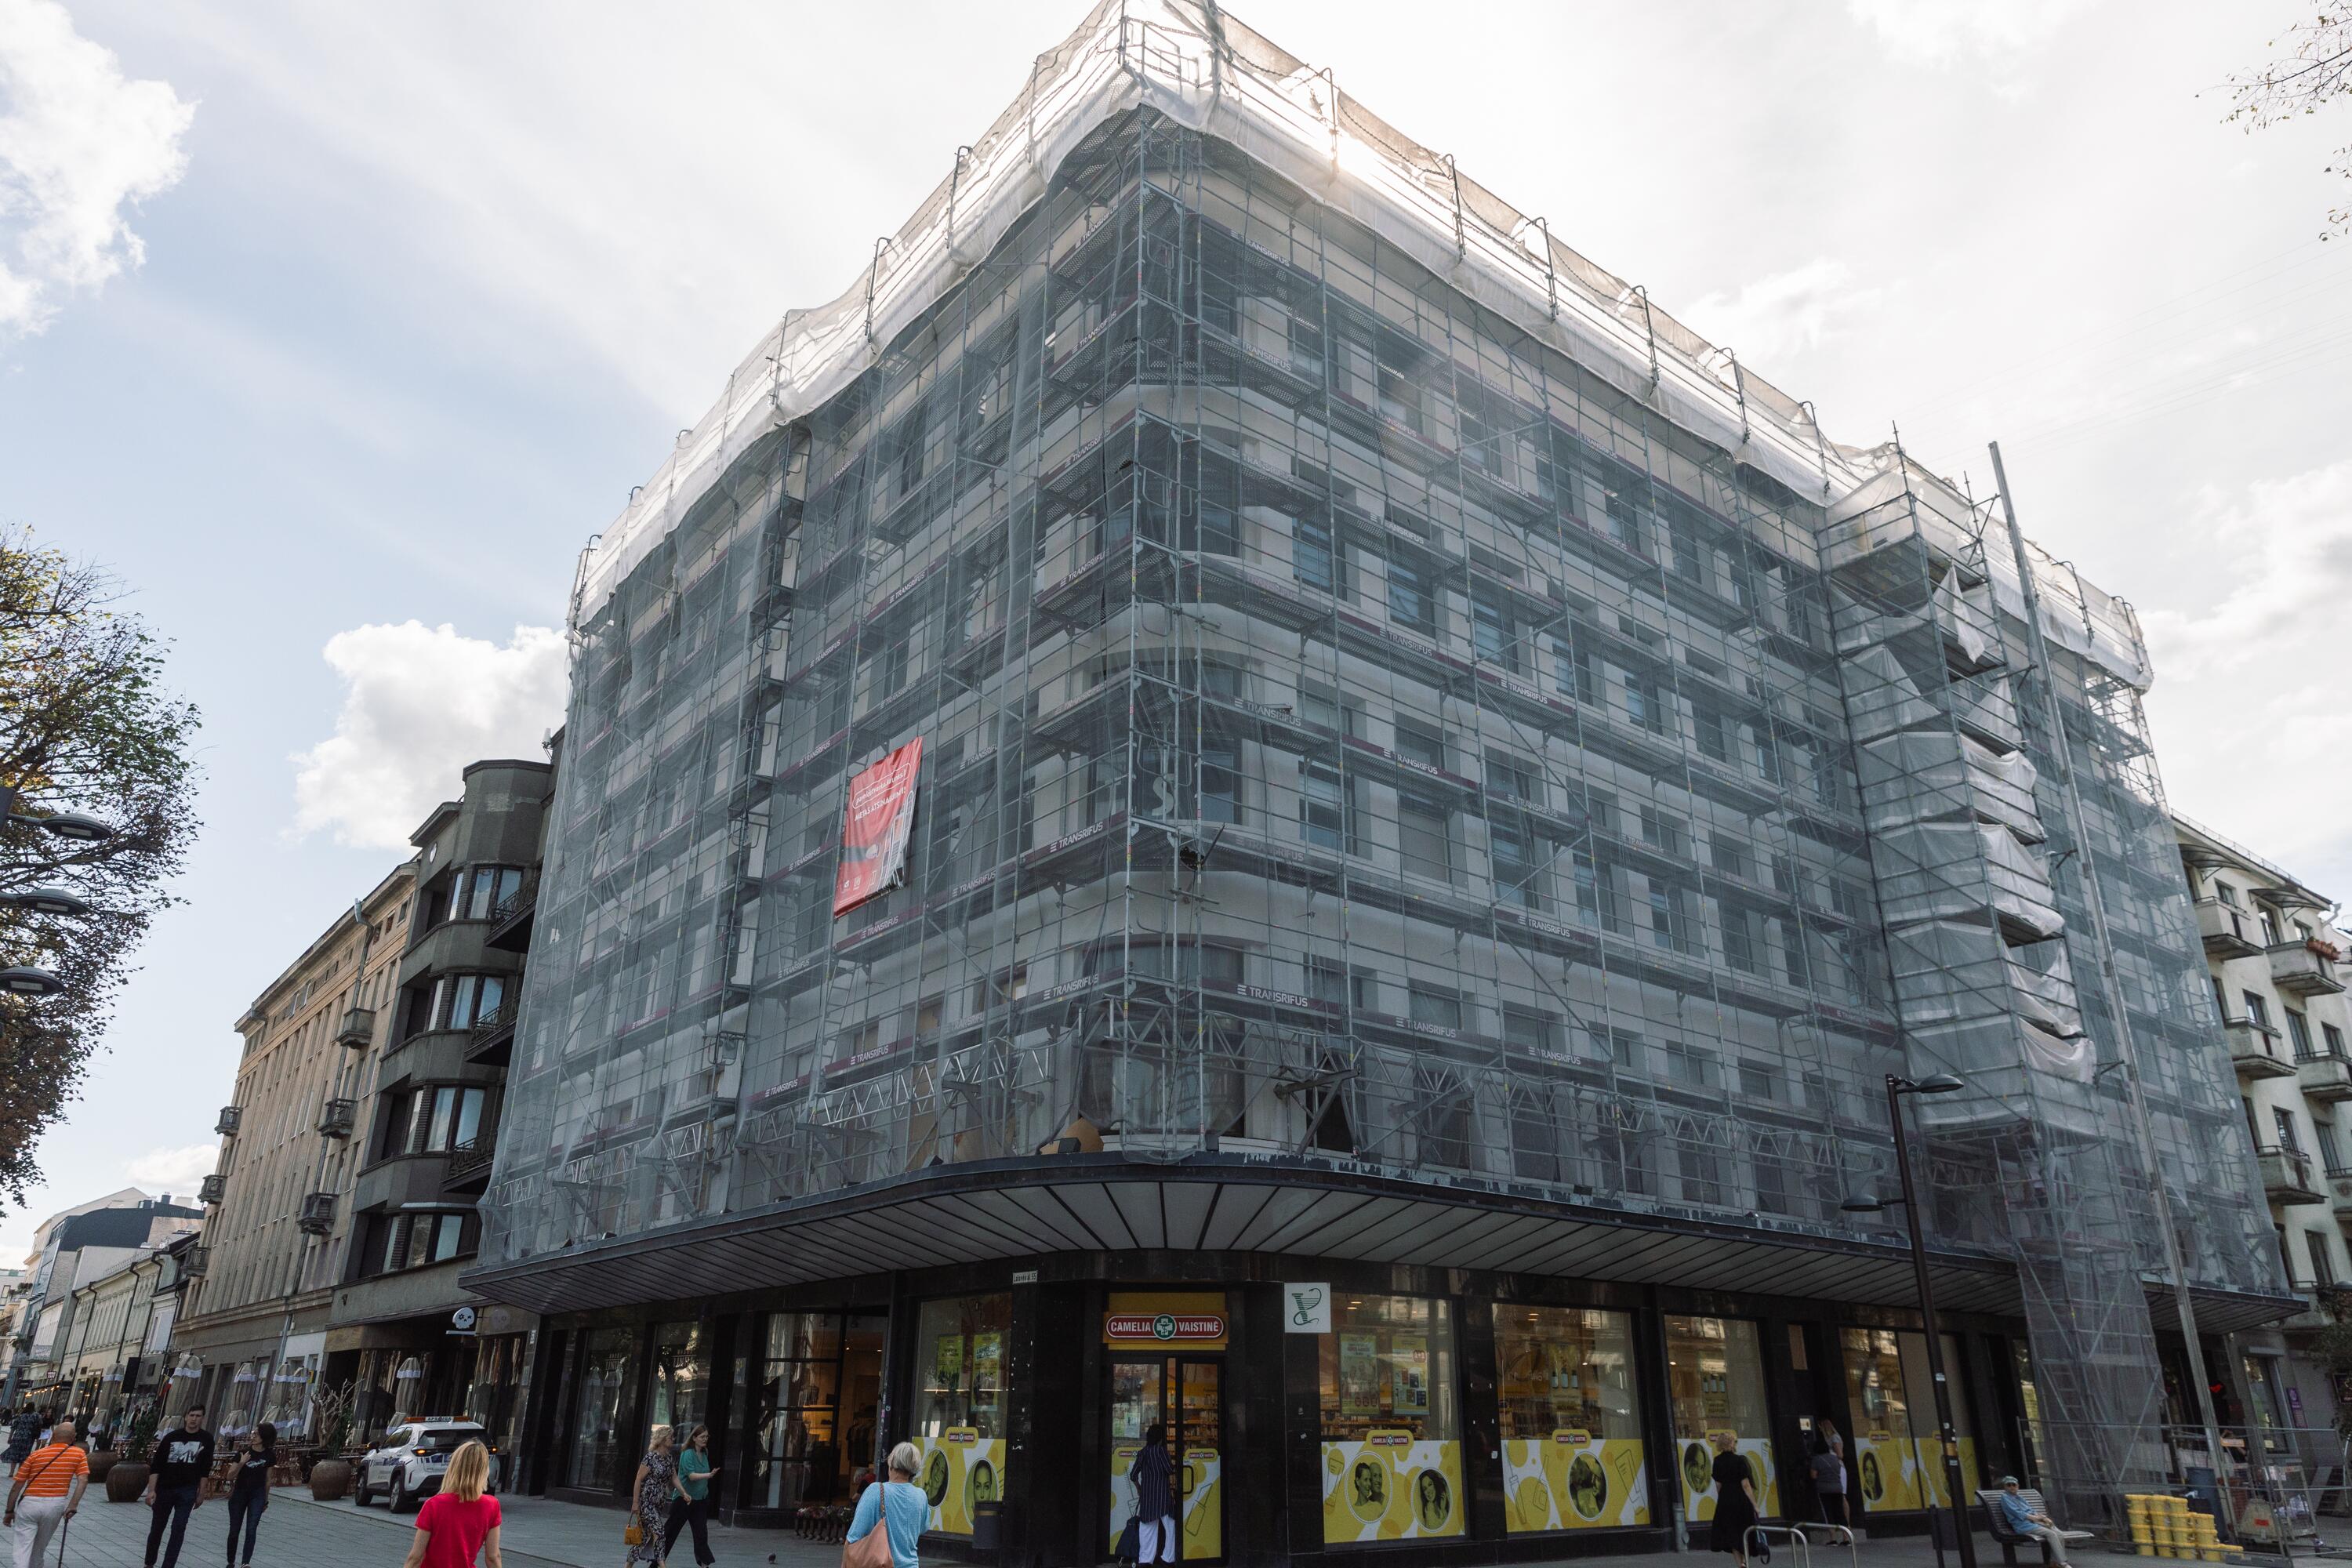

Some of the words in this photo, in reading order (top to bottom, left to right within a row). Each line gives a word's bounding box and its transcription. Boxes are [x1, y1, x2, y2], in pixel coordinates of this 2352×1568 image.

[895, 572, 925, 597] TRANSRIFUS
[815, 640, 841, 662] TRANSRIFUS
[1389, 632, 1433, 655] TRANSRIFUS
[1509, 684, 1548, 703] TRANSRIFUS
[1059, 822, 1104, 848] TRANSRIFUS
[794, 848, 821, 868] TRANSRIFUS
[959, 872, 996, 894] TRANSRIFUS
[867, 916, 898, 935] TRANSRIFUS
[1528, 920, 1570, 938] TRANSRIFUS
[783, 960, 810, 976] TRANSRIFUS
[1054, 974, 1099, 996] TRANSRIFUS
[1250, 986, 1308, 1007] TRANSRIFUS
[857, 1046, 889, 1063] TRANSRIFUS
[771, 1079, 798, 1095] TRANSRIFUS
[1111, 1321, 1151, 1332] CAMELIA
[1178, 1321, 1219, 1332] VAISTINĖ
